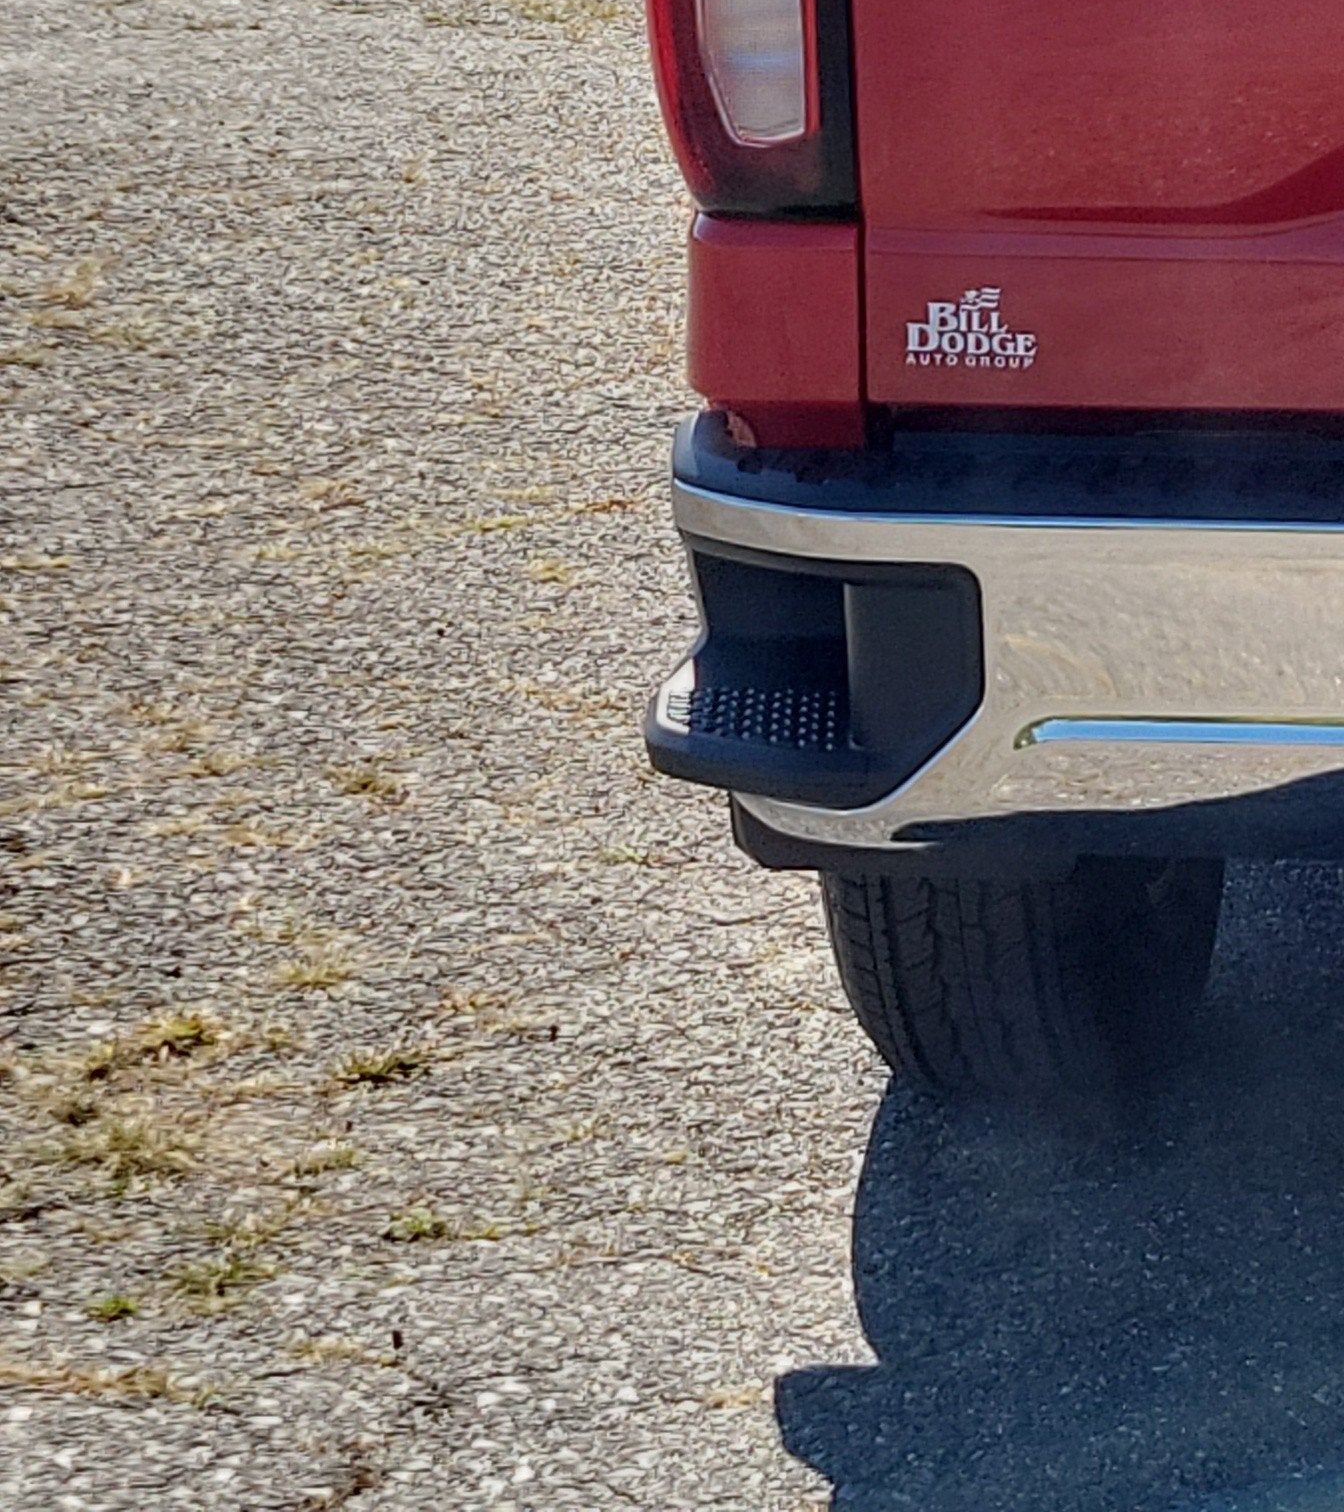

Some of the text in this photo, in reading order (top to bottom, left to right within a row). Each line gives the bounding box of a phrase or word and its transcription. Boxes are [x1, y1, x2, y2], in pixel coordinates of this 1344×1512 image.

[927, 301, 1008, 334] BILL
[906, 322, 1037, 356] DODGE
[906, 353, 1034, 369] AUTO GROUP
